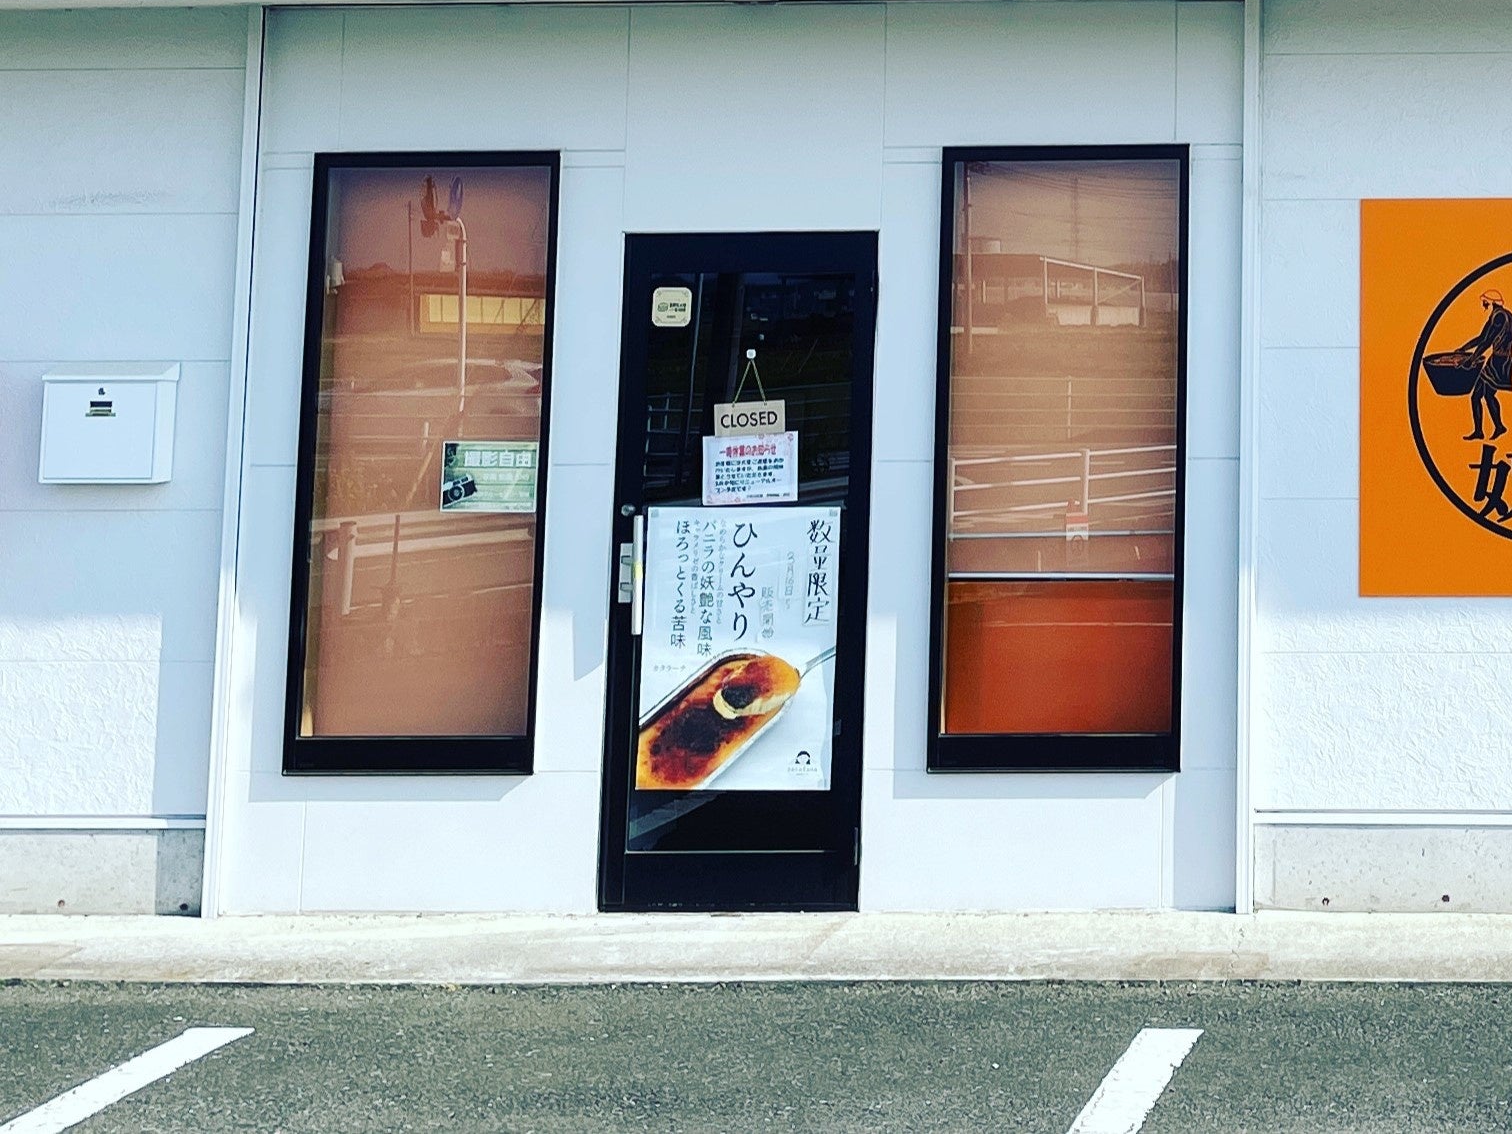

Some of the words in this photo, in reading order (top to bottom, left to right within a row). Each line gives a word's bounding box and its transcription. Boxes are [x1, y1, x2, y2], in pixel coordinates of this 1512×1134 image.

[464, 450, 532, 467] 撮影自由
[720, 411, 778, 428] CLOSED
[670, 520, 691, 649] ほろっとくる苦味
[697, 520, 717, 657] バニラの妖艶な風味
[728, 522, 758, 642] ひんやり
[804, 519, 835, 624] 数量限定
